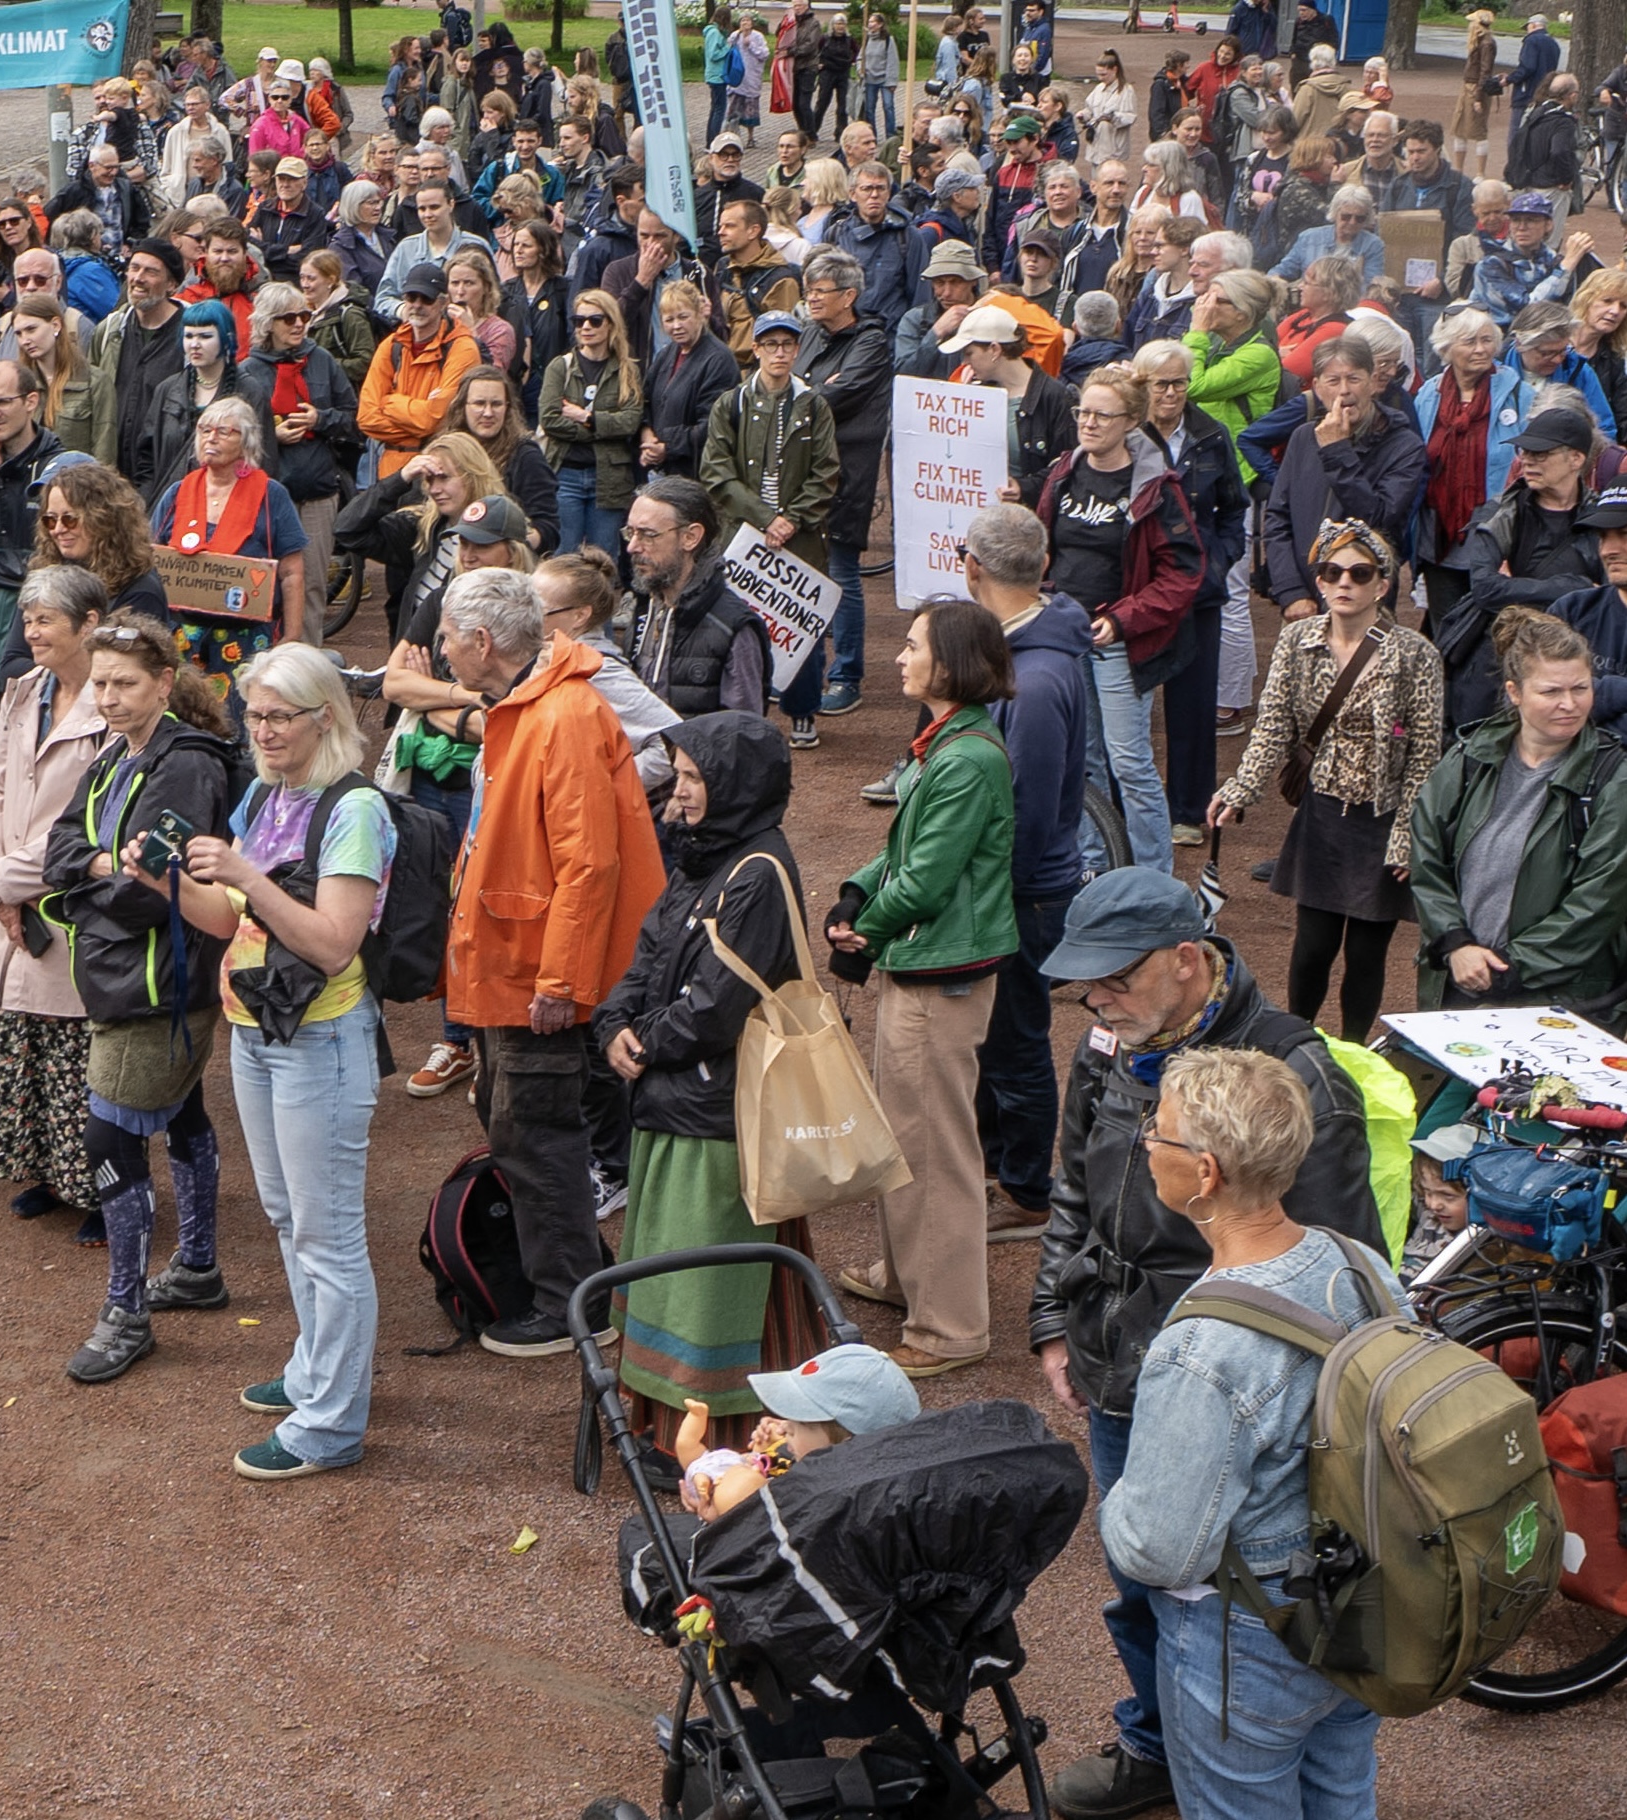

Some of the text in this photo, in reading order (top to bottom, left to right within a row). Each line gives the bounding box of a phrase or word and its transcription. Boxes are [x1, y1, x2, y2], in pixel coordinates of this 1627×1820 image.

[915, 391, 985, 418] TAX THE
[928, 414, 969, 437] RICH
[918, 461, 983, 488] FIX THE
[914, 481, 987, 509] CLIMATE
[929, 531, 968, 551] SAV
[744, 542, 822, 607] FOSSILA
[928, 551, 965, 574] LIVE
[722, 559, 827, 640] SUBVENTIONER
